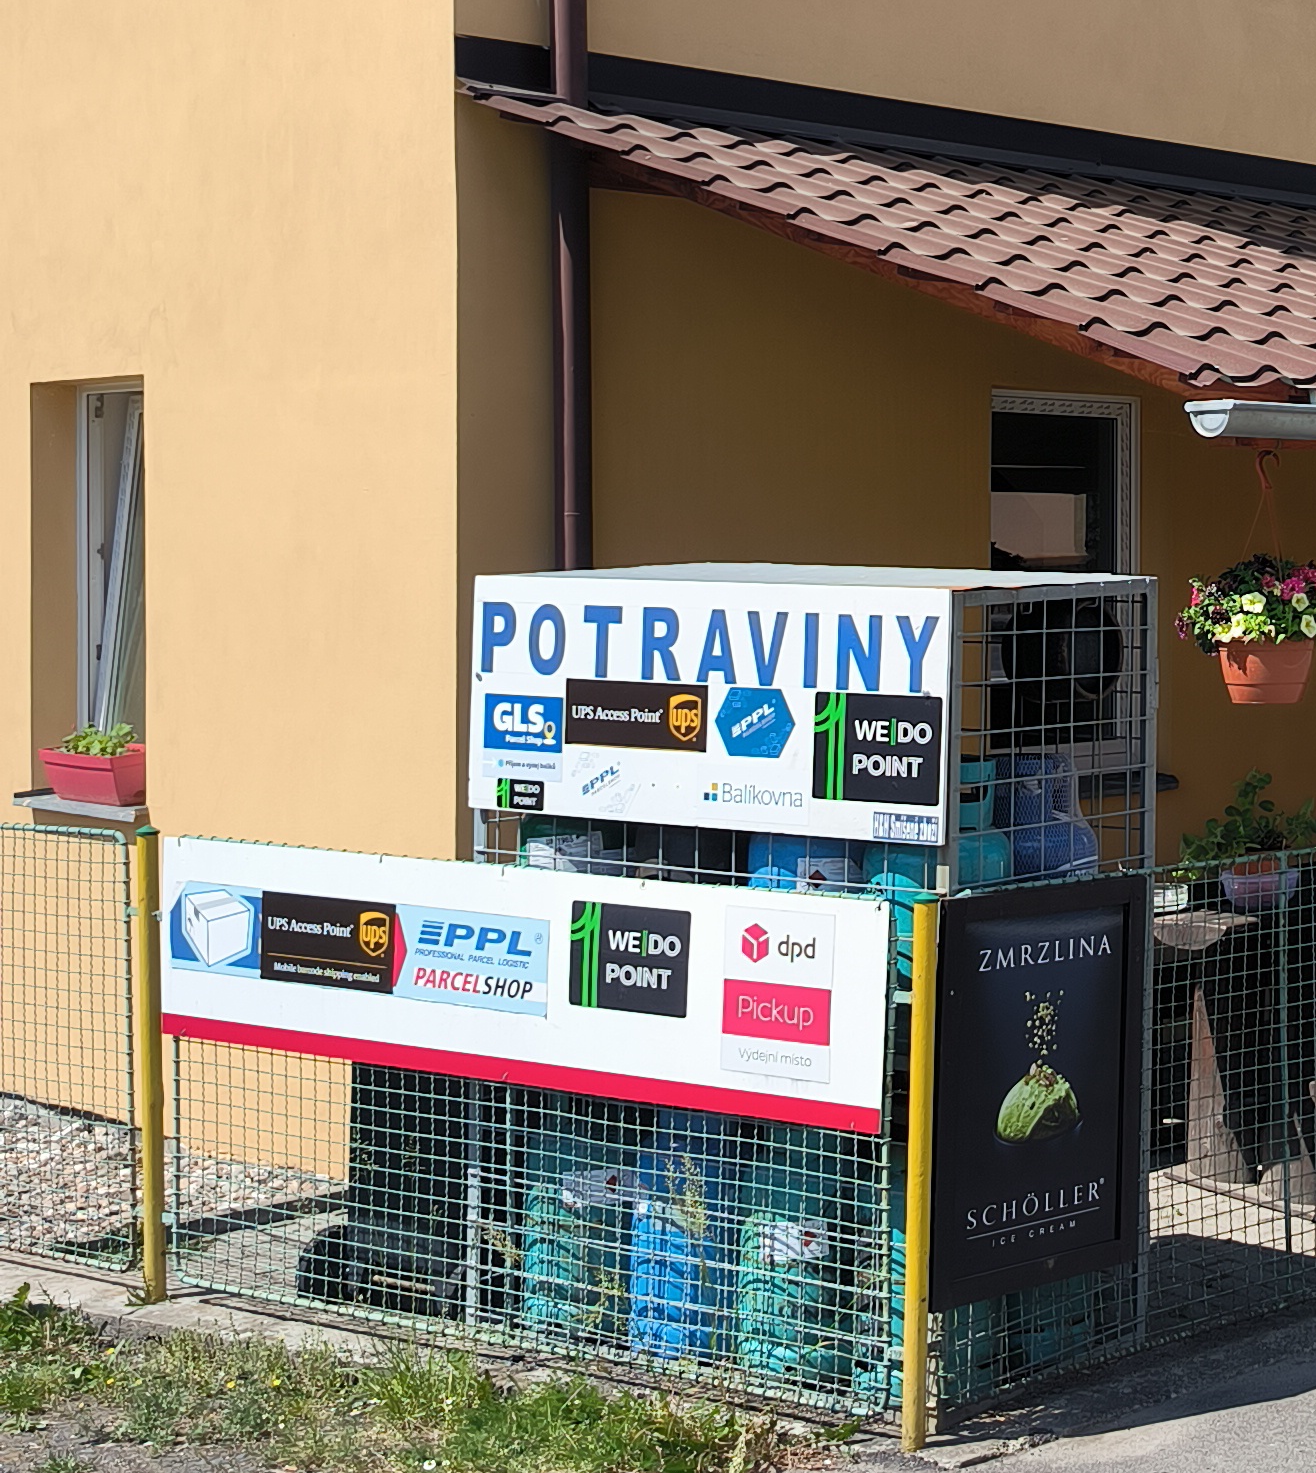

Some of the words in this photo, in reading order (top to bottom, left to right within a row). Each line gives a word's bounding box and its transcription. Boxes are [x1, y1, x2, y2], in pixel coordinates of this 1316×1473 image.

[481, 601, 939, 693] POTRAVINY
[493, 702, 544, 734] GLS
[571, 705, 594, 720] UPS
[595, 708, 629, 723] Access
[630, 709, 662, 724] Point
[672, 708, 699, 734] ups
[852, 754, 924, 778] POINT
[513, 796, 538, 806] POINT
[722, 782, 803, 809] Balíkovna
[268, 916, 288, 931] UPS
[289, 919, 322, 934] Access
[323, 923, 352, 938] Point
[361, 925, 387, 948] ups
[415, 947, 464, 961] PROFESSIONAL
[468, 954, 494, 965] PARCEL
[498, 958, 530, 969] LOGISTIC
[778, 934, 816, 963] dpd
[979, 934, 1111, 972] ZMRZLINA
[274, 962, 297, 973] Mobile
[605, 963, 672, 989] POINT
[738, 995, 814, 1031] Pickup
[738, 1047, 779, 1066] Výdejní
[781, 1054, 812, 1068] místo
[966, 1180, 1101, 1230] SCHÖLLER
[992, 1234, 1016, 1247] ICE
[1029, 1220, 1076, 1239] CREAM
